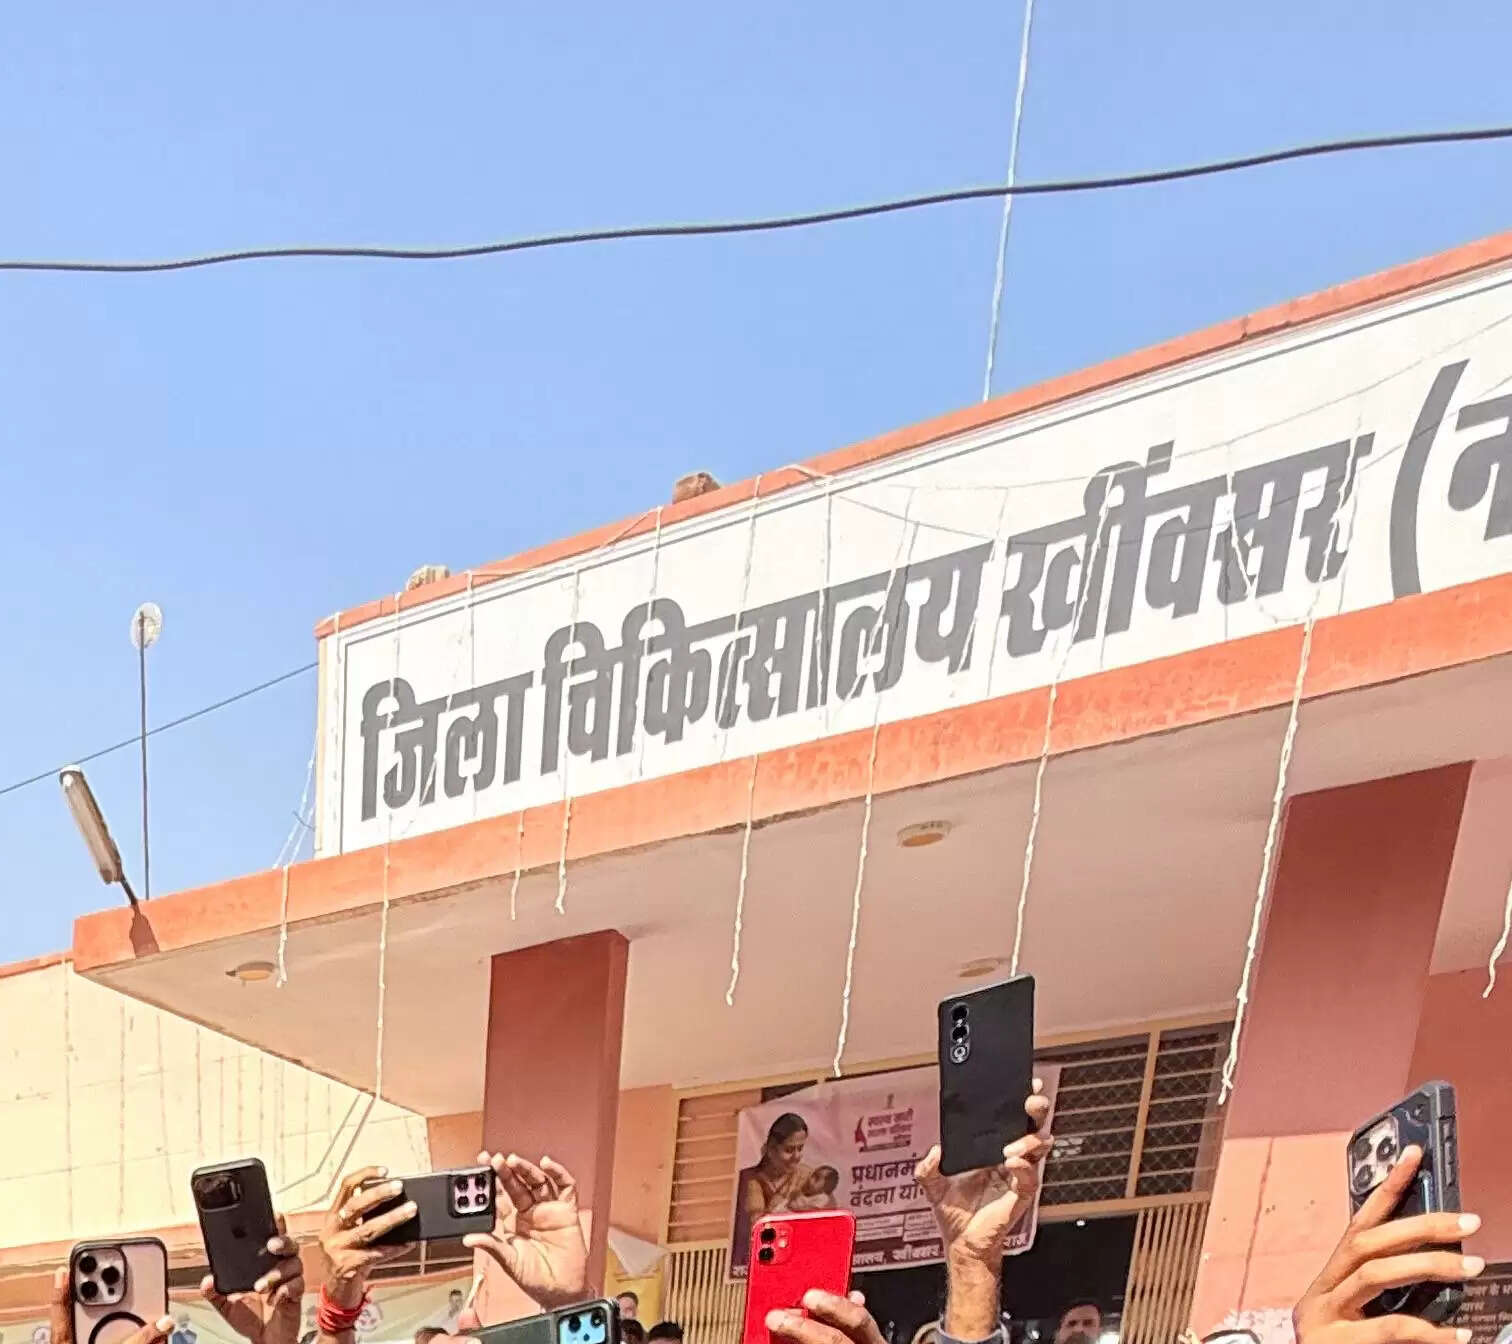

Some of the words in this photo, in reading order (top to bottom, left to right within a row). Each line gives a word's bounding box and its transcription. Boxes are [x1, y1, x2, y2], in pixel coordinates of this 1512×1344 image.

[361, 671, 535, 822] जिला
[541, 540, 994, 776] चिकित्सालय
[851, 1152, 920, 1184] प्रधानमं
[850, 1184, 896, 1207] वंदना
